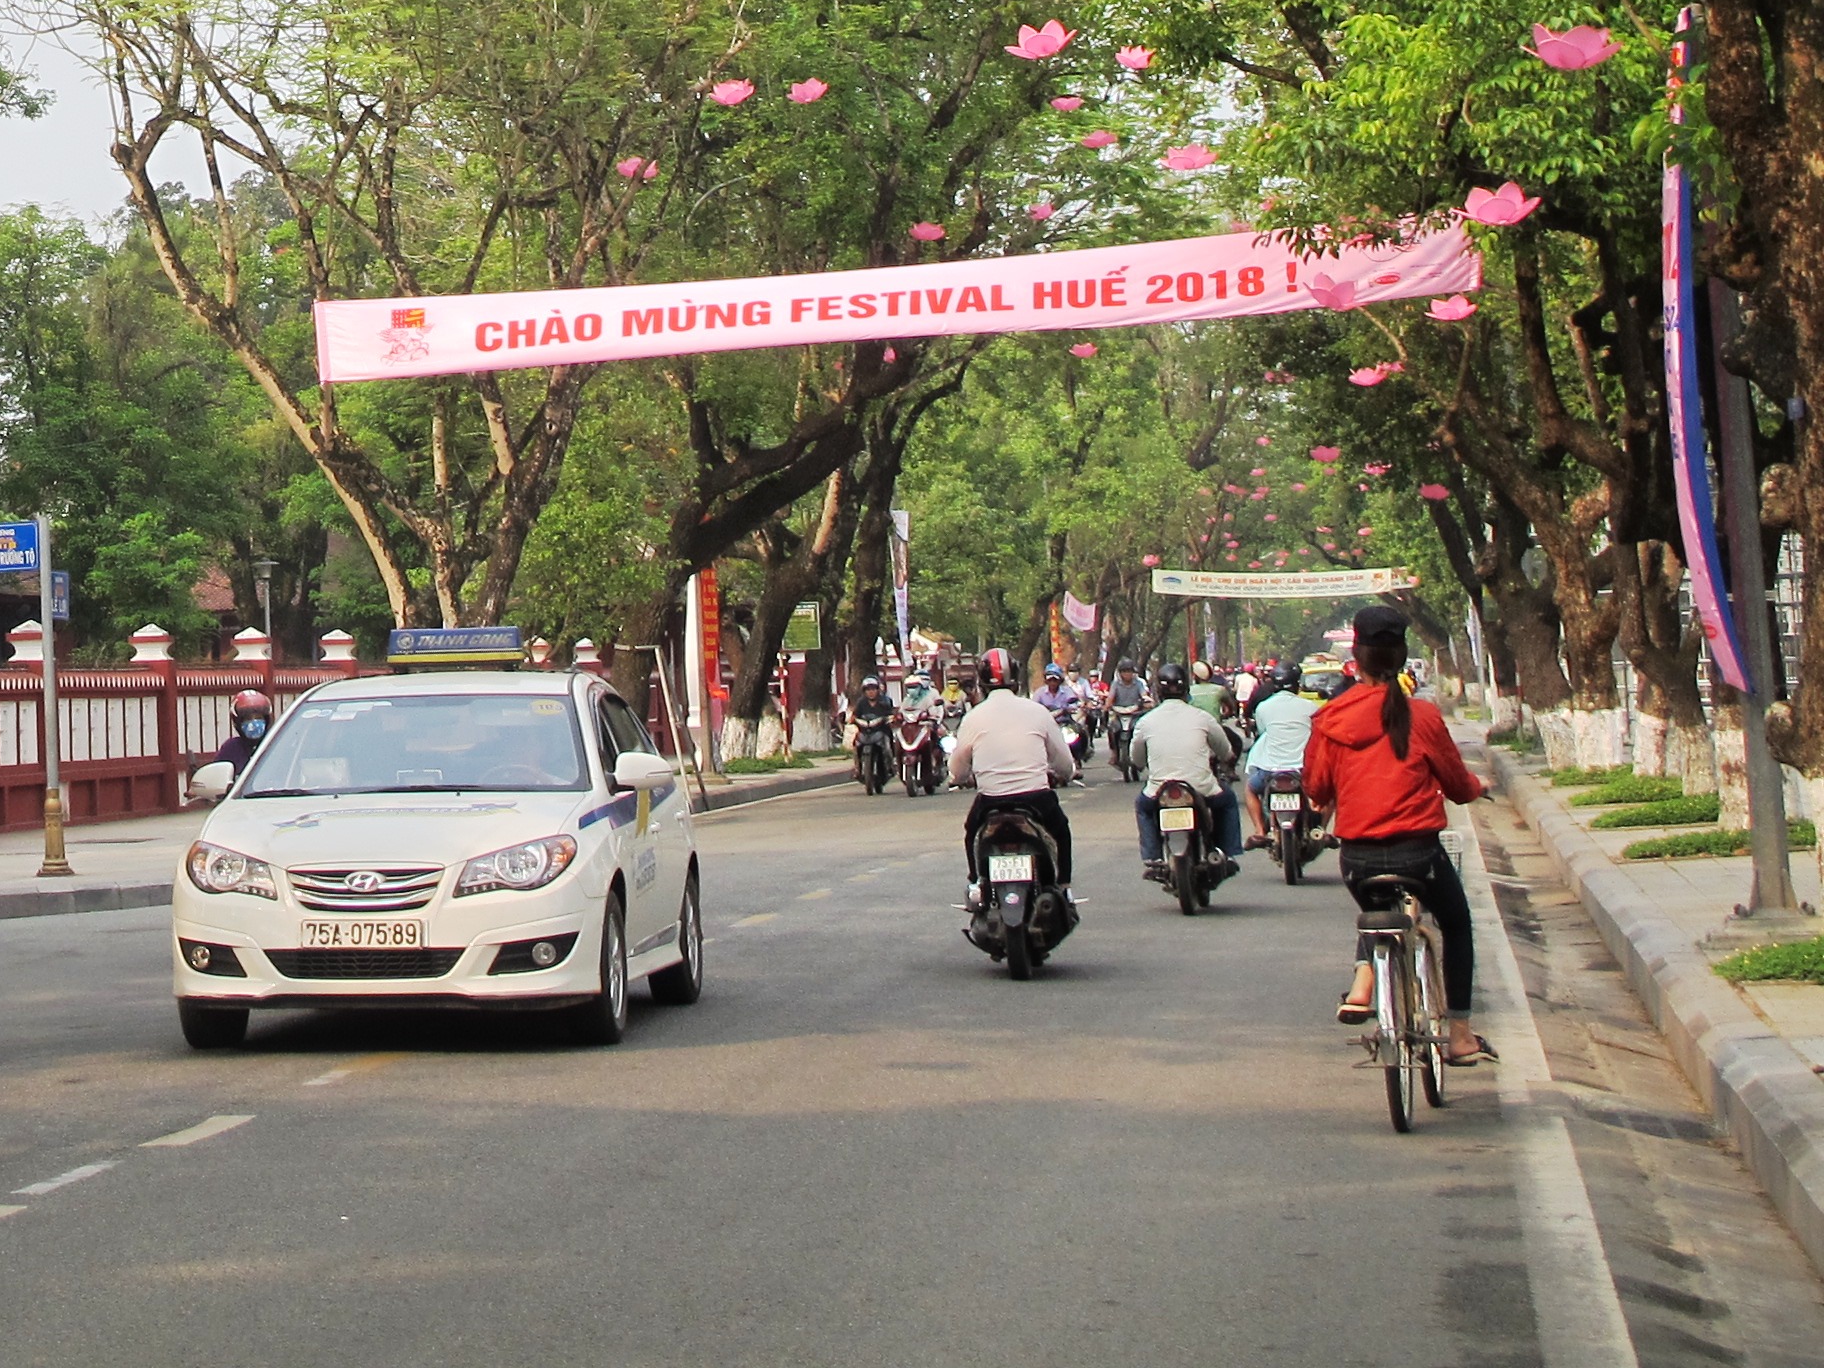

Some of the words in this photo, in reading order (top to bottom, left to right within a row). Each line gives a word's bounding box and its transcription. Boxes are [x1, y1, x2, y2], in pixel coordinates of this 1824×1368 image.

[475, 309, 602, 352] CHÀO
[622, 299, 771, 337] MỪNG
[790, 285, 1014, 323] FESTIVAL
[1033, 265, 1130, 309] HUẾ
[1146, 266, 1265, 305] 2018
